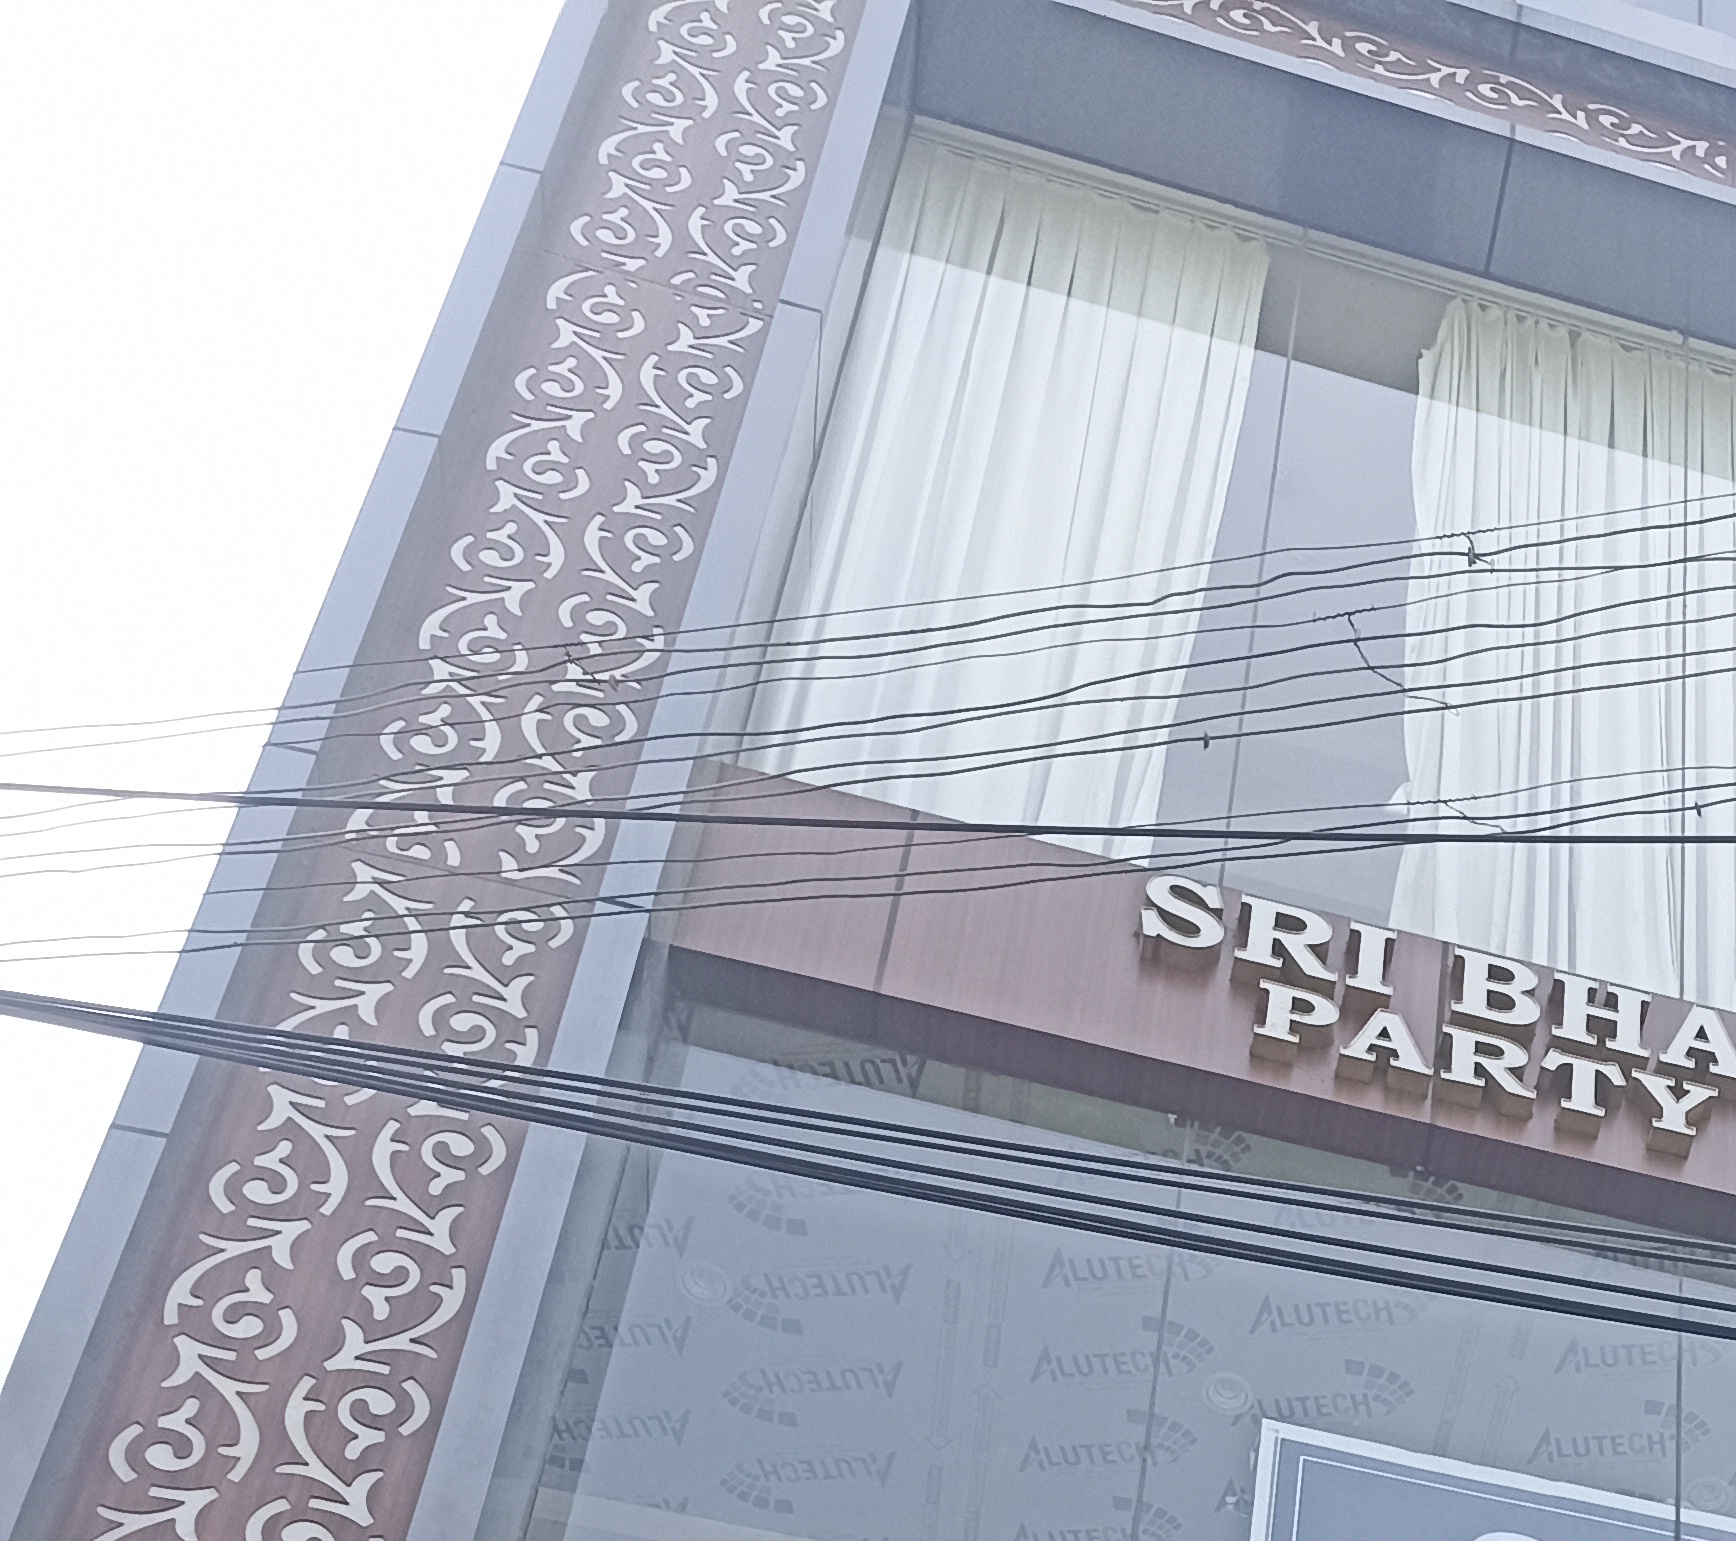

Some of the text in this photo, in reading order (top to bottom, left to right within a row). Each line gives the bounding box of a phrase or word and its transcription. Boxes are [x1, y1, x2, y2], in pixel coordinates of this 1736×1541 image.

[1139, 874, 1399, 995] SRI
[1252, 978, 1720, 1136] PARTY
[601, 1215, 696, 1259] ALUT
[763, 1262, 914, 1305] ALUTECH
[1041, 1247, 1190, 1289] ALUTECH
[1249, 1293, 1400, 1335] ALUTECH
[579, 1315, 694, 1356] ALUTEC
[1553, 1336, 1699, 1375] ALUTECH
[759, 1360, 904, 1399] ALUTECH
[1029, 1345, 1173, 1384] ALUTECH
[552, 1408, 692, 1447] ALUTECH
[1526, 1426, 1667, 1465] ALUTECH
[757, 1451, 897, 1488] ALUTECH
[1018, 1434, 1157, 1473] ALUTECH
